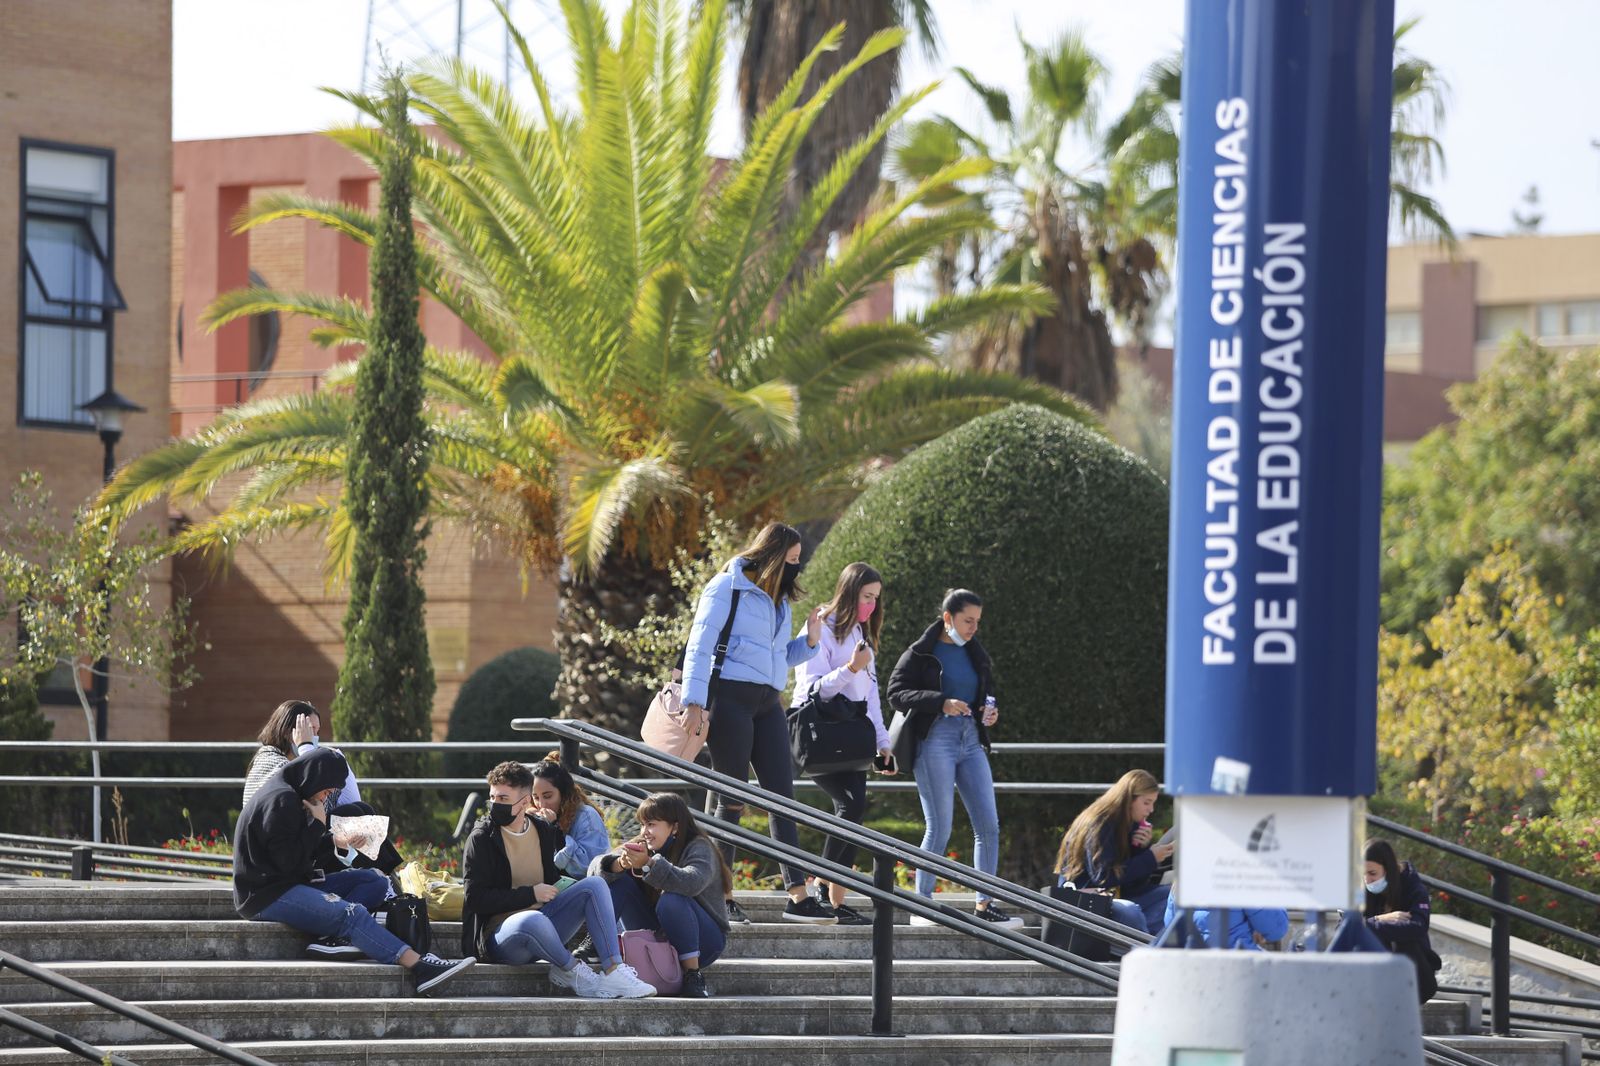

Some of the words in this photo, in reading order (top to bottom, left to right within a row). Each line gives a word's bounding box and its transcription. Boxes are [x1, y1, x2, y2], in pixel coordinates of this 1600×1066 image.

[1210, 97, 1250, 326] CIENCIAS
[1208, 336, 1242, 404] DE
[1254, 224, 1305, 508] EDUCACIÓN
[1202, 416, 1242, 665] FACULTAD
[1256, 521, 1299, 583] LA
[1253, 599, 1297, 664] DE
